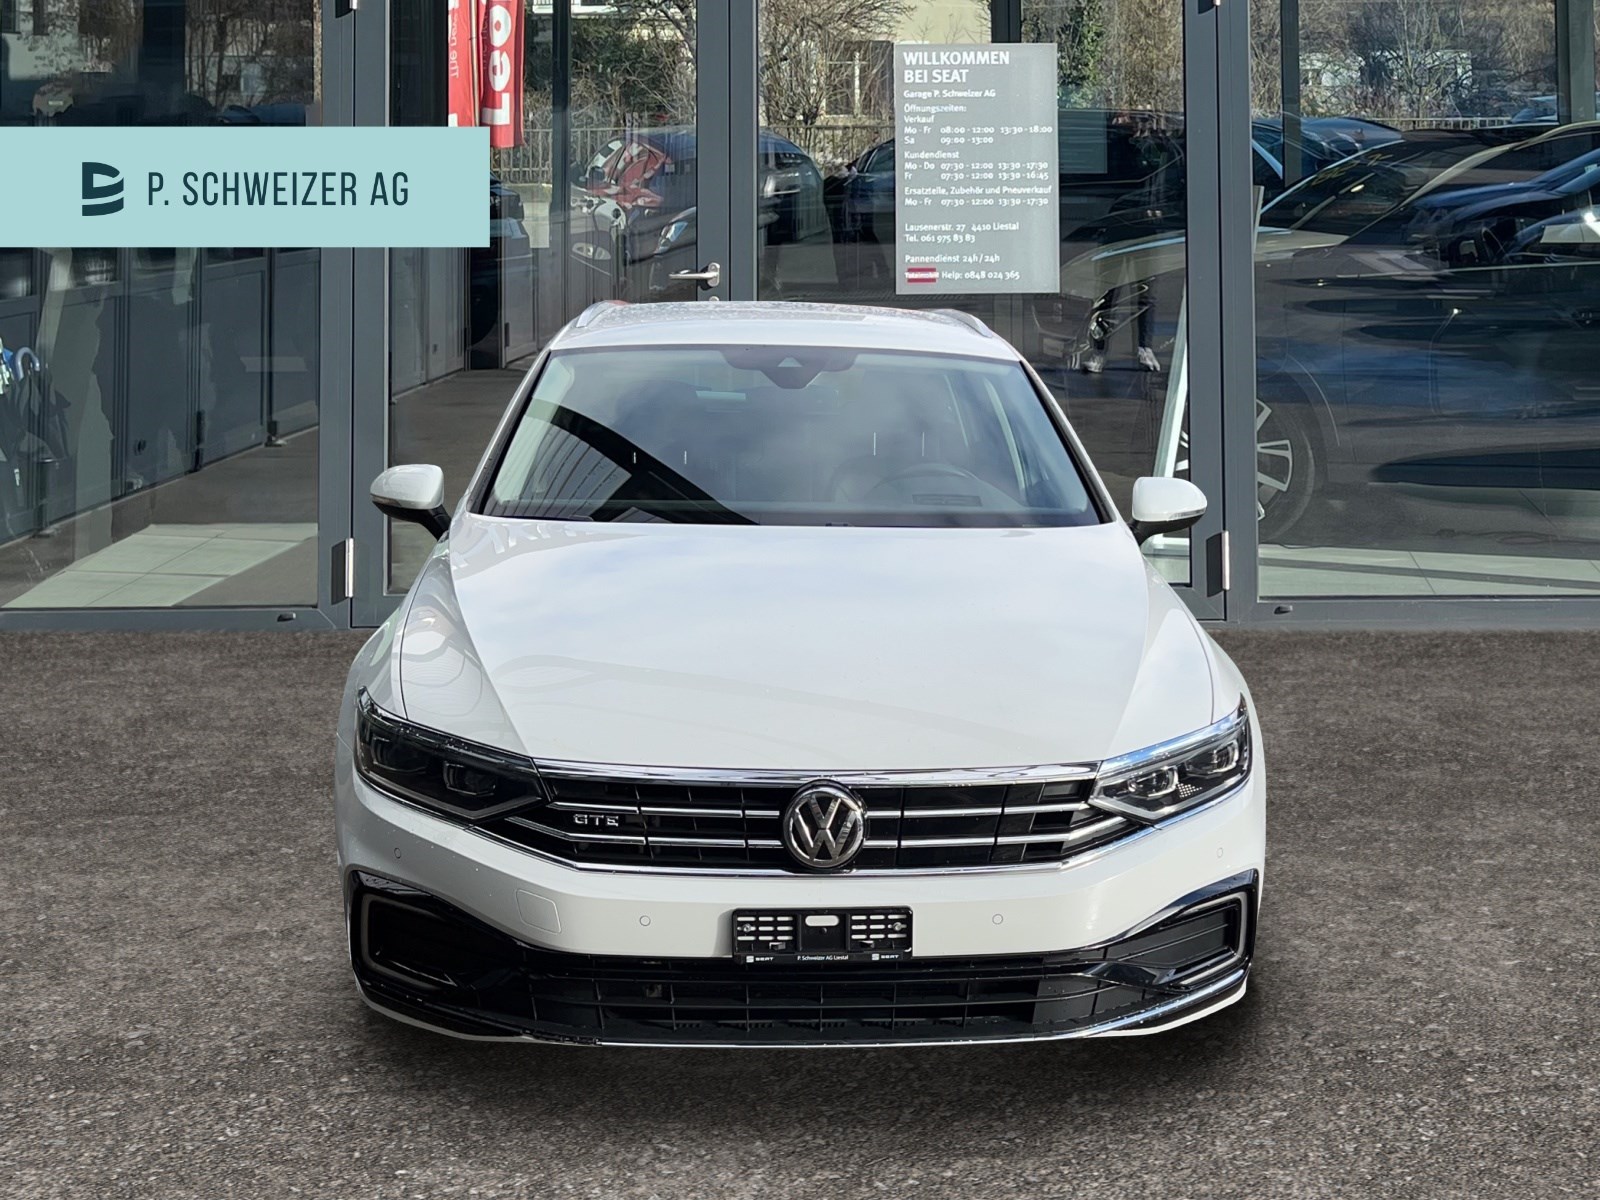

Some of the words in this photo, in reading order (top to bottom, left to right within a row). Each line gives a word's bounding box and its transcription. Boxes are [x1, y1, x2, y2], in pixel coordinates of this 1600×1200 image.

[904, 52, 1010, 65] WILLKOMMEN
[904, 70, 928, 82] BEI
[932, 70, 969, 82] SEAT
[904, 90, 932, 99] Garage
[904, 104, 967, 113] Öffnungszeiten:
[951, 186, 983, 194] Zubehör
[953, 234, 963, 243] 83
[965, 234, 975, 242] 83
[985, 254, 1000, 263] 24h
[1005, 271, 1020, 280] 365
[786, 783, 865, 867] VW
